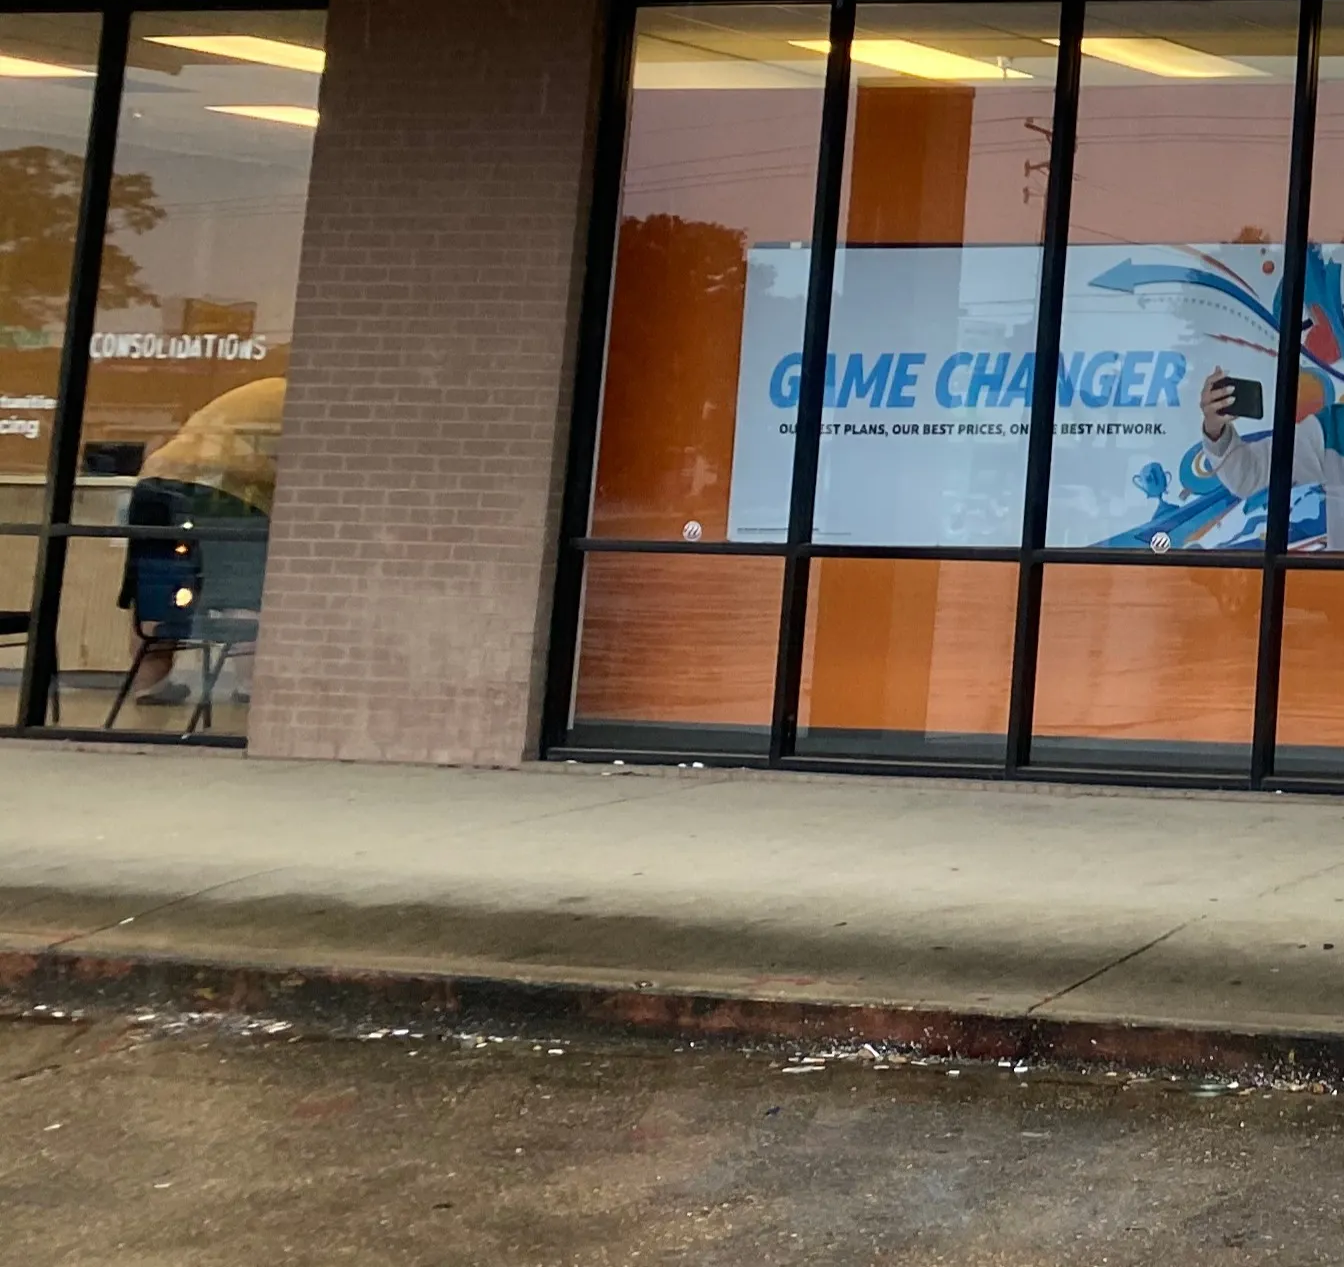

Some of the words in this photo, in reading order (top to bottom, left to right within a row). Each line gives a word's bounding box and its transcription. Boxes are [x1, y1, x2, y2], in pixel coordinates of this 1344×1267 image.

[89, 333, 268, 361] CONSOLIDATIONS
[935, 350, 1186, 409] CHANGER
[843, 423, 889, 437] PLANS,
[892, 423, 920, 436] OUR
[922, 423, 955, 436] BEST
[957, 423, 1006, 437] PRICES,
[1061, 423, 1094, 435] BEST
[1096, 423, 1167, 436] NETWORK.
